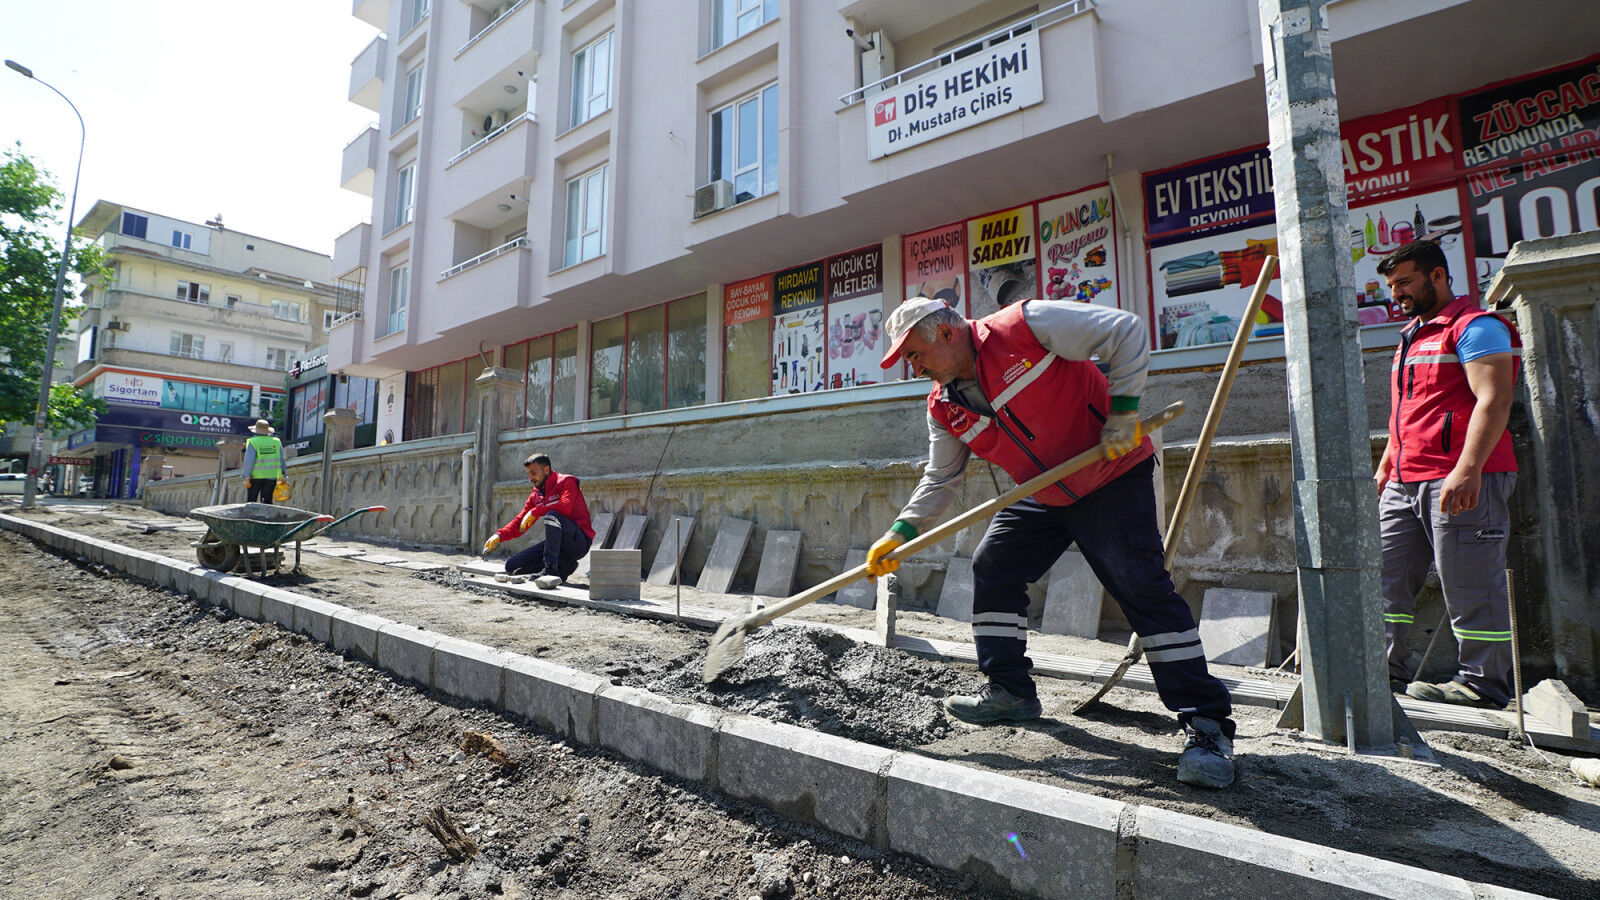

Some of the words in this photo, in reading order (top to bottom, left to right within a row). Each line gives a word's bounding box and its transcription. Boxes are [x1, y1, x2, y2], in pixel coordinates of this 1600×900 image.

[904, 84, 938, 115] DİŞ
[944, 43, 1029, 100] HEKİMİ
[970, 86, 1013, 115] ÇİRİŞ
[1473, 65, 1600, 142] ZÜCCAC
[1341, 113, 1454, 176] ASTİK
[1463, 113, 1584, 167] REYONUNDA
[1466, 157, 1517, 197] NE
[1521, 127, 1600, 181] ALIR
[1155, 180, 1181, 218] EV
[1186, 153, 1274, 211] TEKSTİL
[1345, 170, 1410, 202] EYONU
[980, 216, 1019, 243] HALI
[1041, 197, 1111, 244] OYUNCAK
[1190, 204, 1251, 234] REYONU
[920, 229, 963, 259] ÇAMAŞIRI
[972, 235, 1031, 266] SARAYI
[1048, 226, 1109, 266] Reyonu
[778, 267, 819, 291] HIRDAVAT
[830, 254, 864, 279] KÜÇÜK
[865, 251, 878, 270] EV
[918, 254, 954, 278] REYONU
[730, 281, 765, 299] BAY-BAYAN
[833, 268, 877, 298] ALETLERİ
[727, 296, 750, 311] ÇOCUK
[734, 305, 761, 320] REYONU
[781, 287, 816, 310] REYONU
[109, 384, 158, 397] Sigortam
